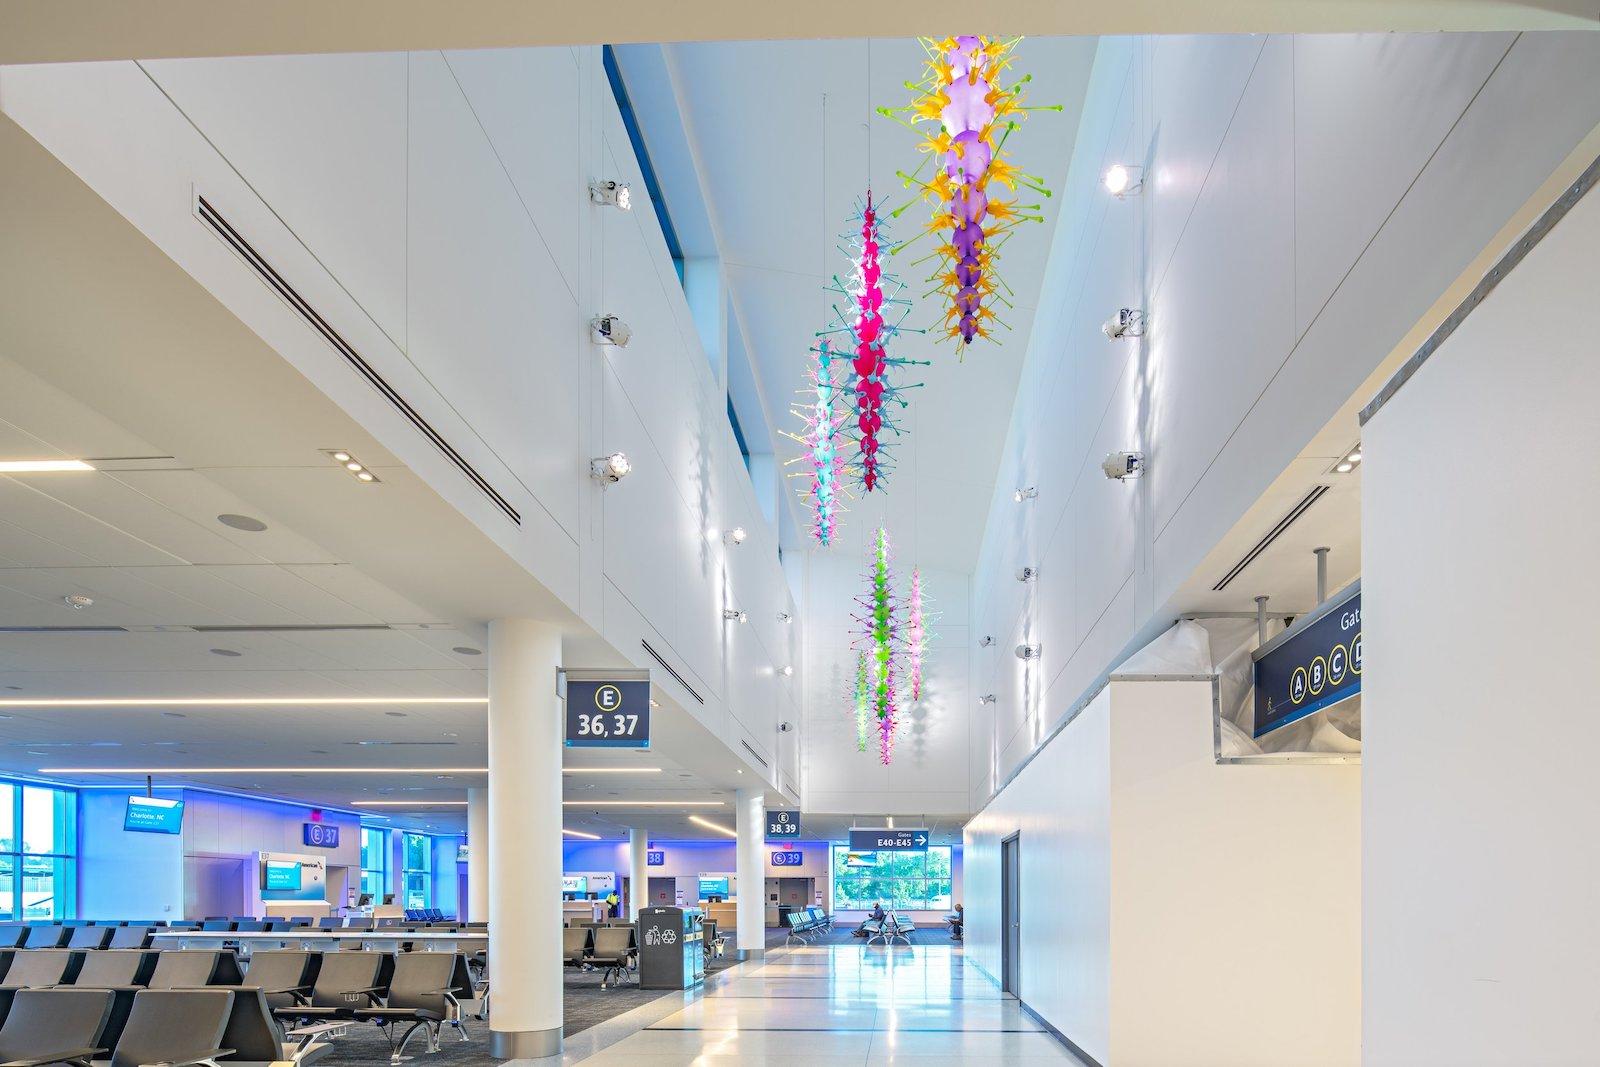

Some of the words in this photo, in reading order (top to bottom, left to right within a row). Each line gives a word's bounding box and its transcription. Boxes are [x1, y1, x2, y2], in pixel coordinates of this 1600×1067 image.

[1340, 608, 1361, 630] Gat
[1294, 675, 1303, 694] A
[1313, 665, 1321, 684] B
[1332, 652, 1342, 673] C
[603, 690, 614, 706] E
[577, 714, 609, 738] 36,
[613, 714, 639, 736] 37
[780, 814, 787, 822] E
[770, 824, 784, 834] 38,
[785, 824, 797, 833] 39
[325, 828, 337, 844] 37
[877, 839, 912, 847] E40-E45
[648, 853, 661, 863] 38
[787, 853, 800, 863] 39
